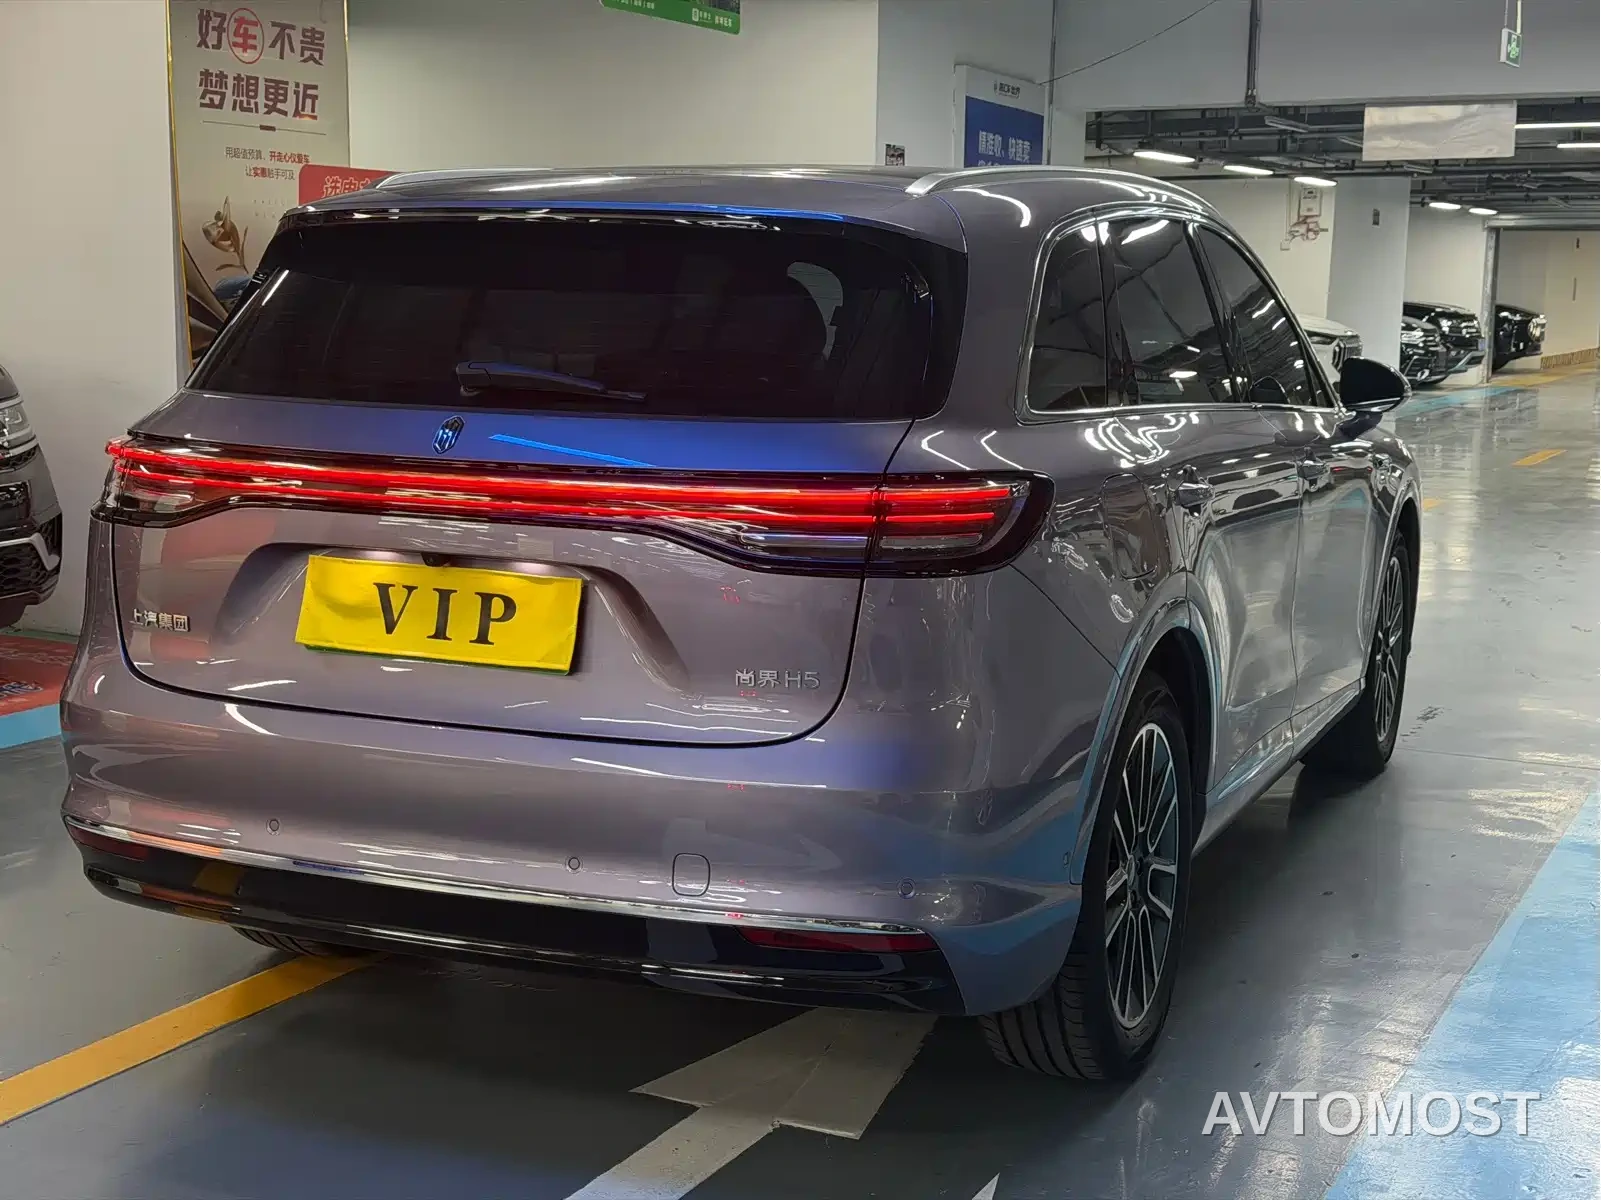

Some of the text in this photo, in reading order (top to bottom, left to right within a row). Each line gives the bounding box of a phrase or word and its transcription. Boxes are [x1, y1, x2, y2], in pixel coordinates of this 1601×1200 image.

[197, 8, 326, 66] 好车不贵
[198, 68, 319, 120] 梦想更近
[129, 608, 189, 632] 上汽集团
[373, 582, 517, 646] VIP
[735, 668, 820, 689] 尚界 H5
